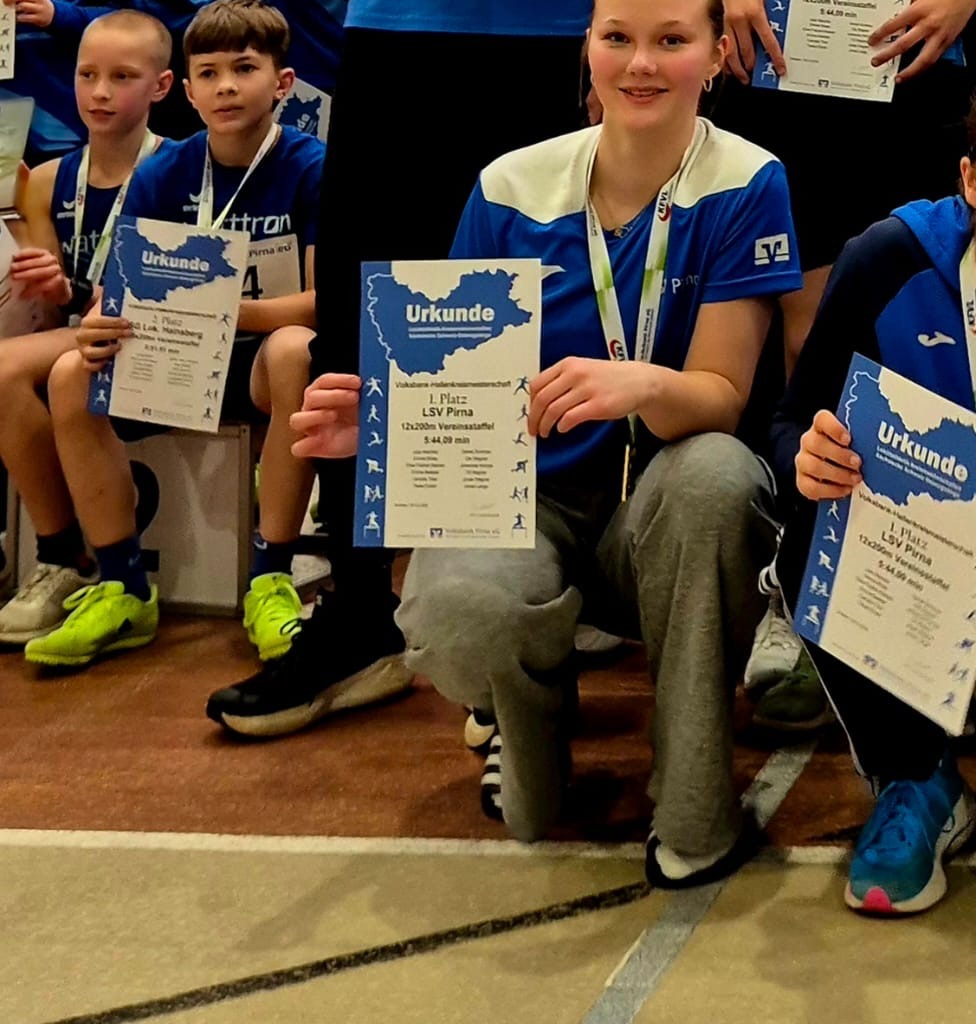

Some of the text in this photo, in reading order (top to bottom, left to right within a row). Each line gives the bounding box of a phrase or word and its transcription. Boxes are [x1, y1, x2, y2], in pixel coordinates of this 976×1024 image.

[223, 212, 291, 235] ttron
[141, 250, 210, 272] Urkunde
[406, 303, 495, 323] Urkunde
[439, 392, 468, 404] Platz
[422, 406, 474, 417] LSV Pirna
[878, 421, 969, 483] Urkunde
[881, 530, 932, 567] LSV Pirna
